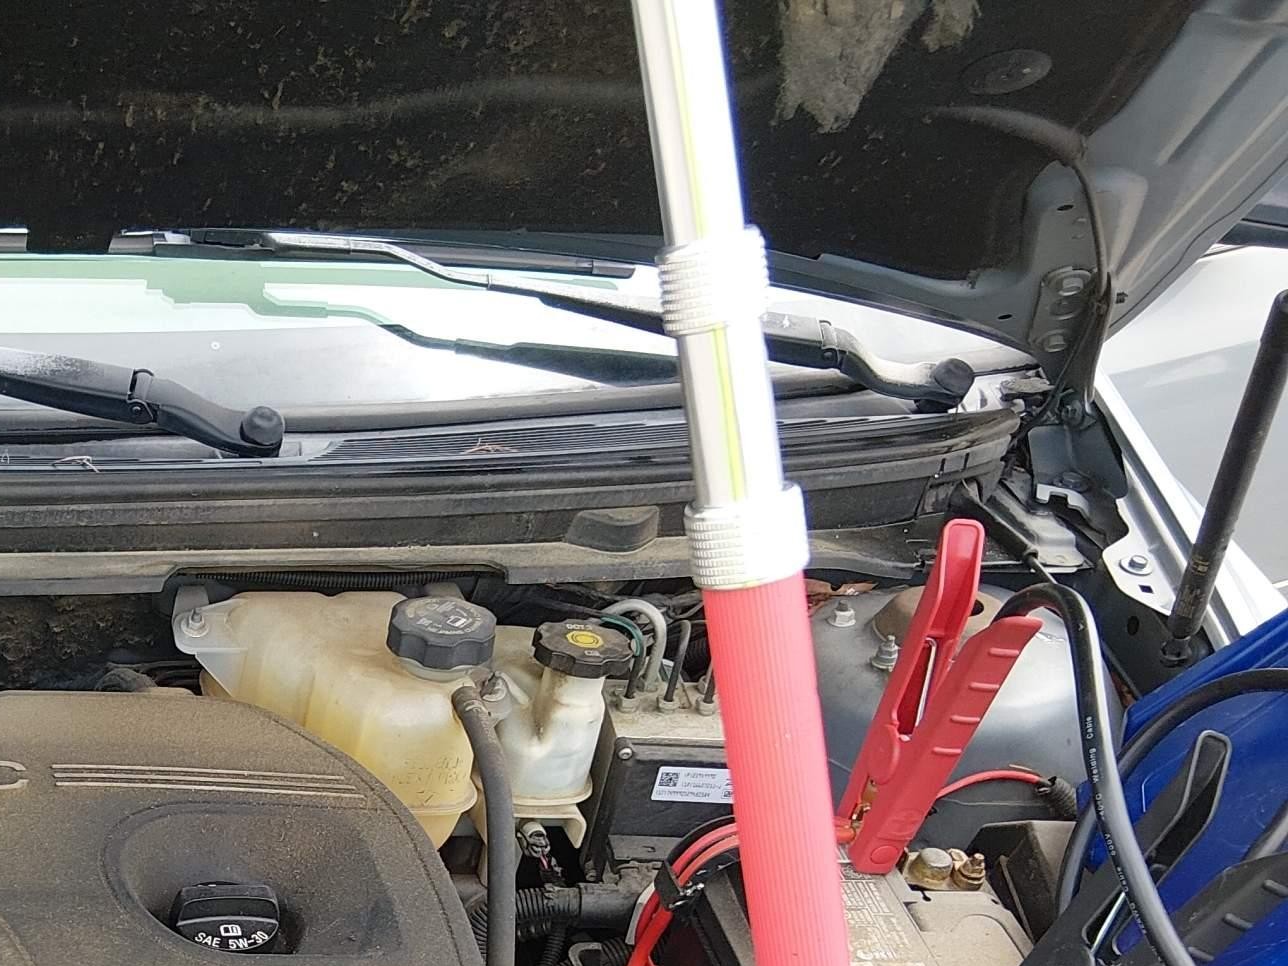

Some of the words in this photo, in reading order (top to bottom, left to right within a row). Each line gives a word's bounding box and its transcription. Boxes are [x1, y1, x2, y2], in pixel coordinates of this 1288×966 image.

[1086, 716, 1094, 740] Cable
[1089, 748, 1099, 784] Welding
[194, 932, 222, 948] SAE
[228, 930, 269, 949] 5W-30
